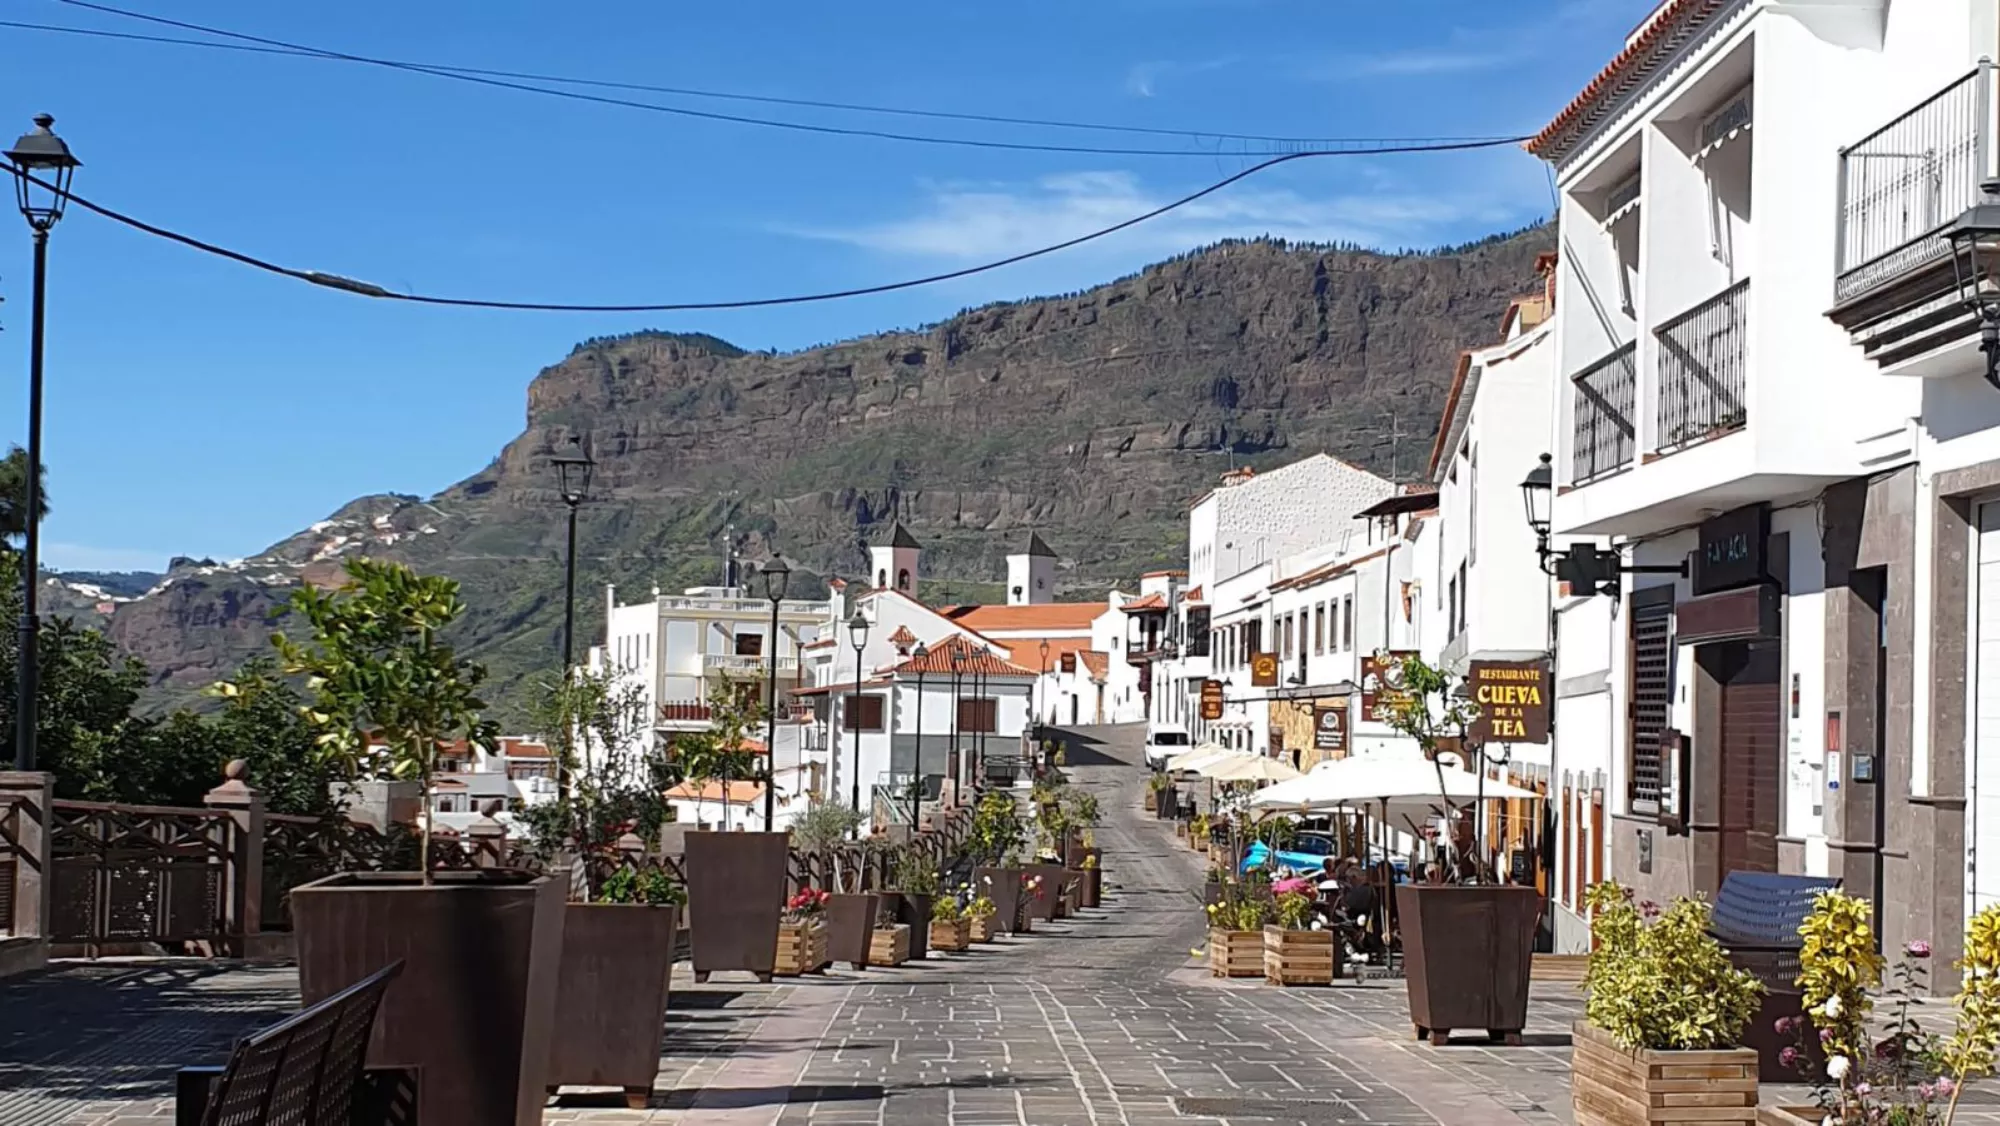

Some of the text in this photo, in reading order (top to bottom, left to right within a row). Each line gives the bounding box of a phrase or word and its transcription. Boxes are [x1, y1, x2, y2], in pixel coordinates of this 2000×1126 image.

[1480, 669, 1540, 680] RESTAURANTE
[1477, 685, 1541, 705] CUEVA
[1494, 707, 1523, 717] DE LA
[1492, 720, 1526, 736] TEA
